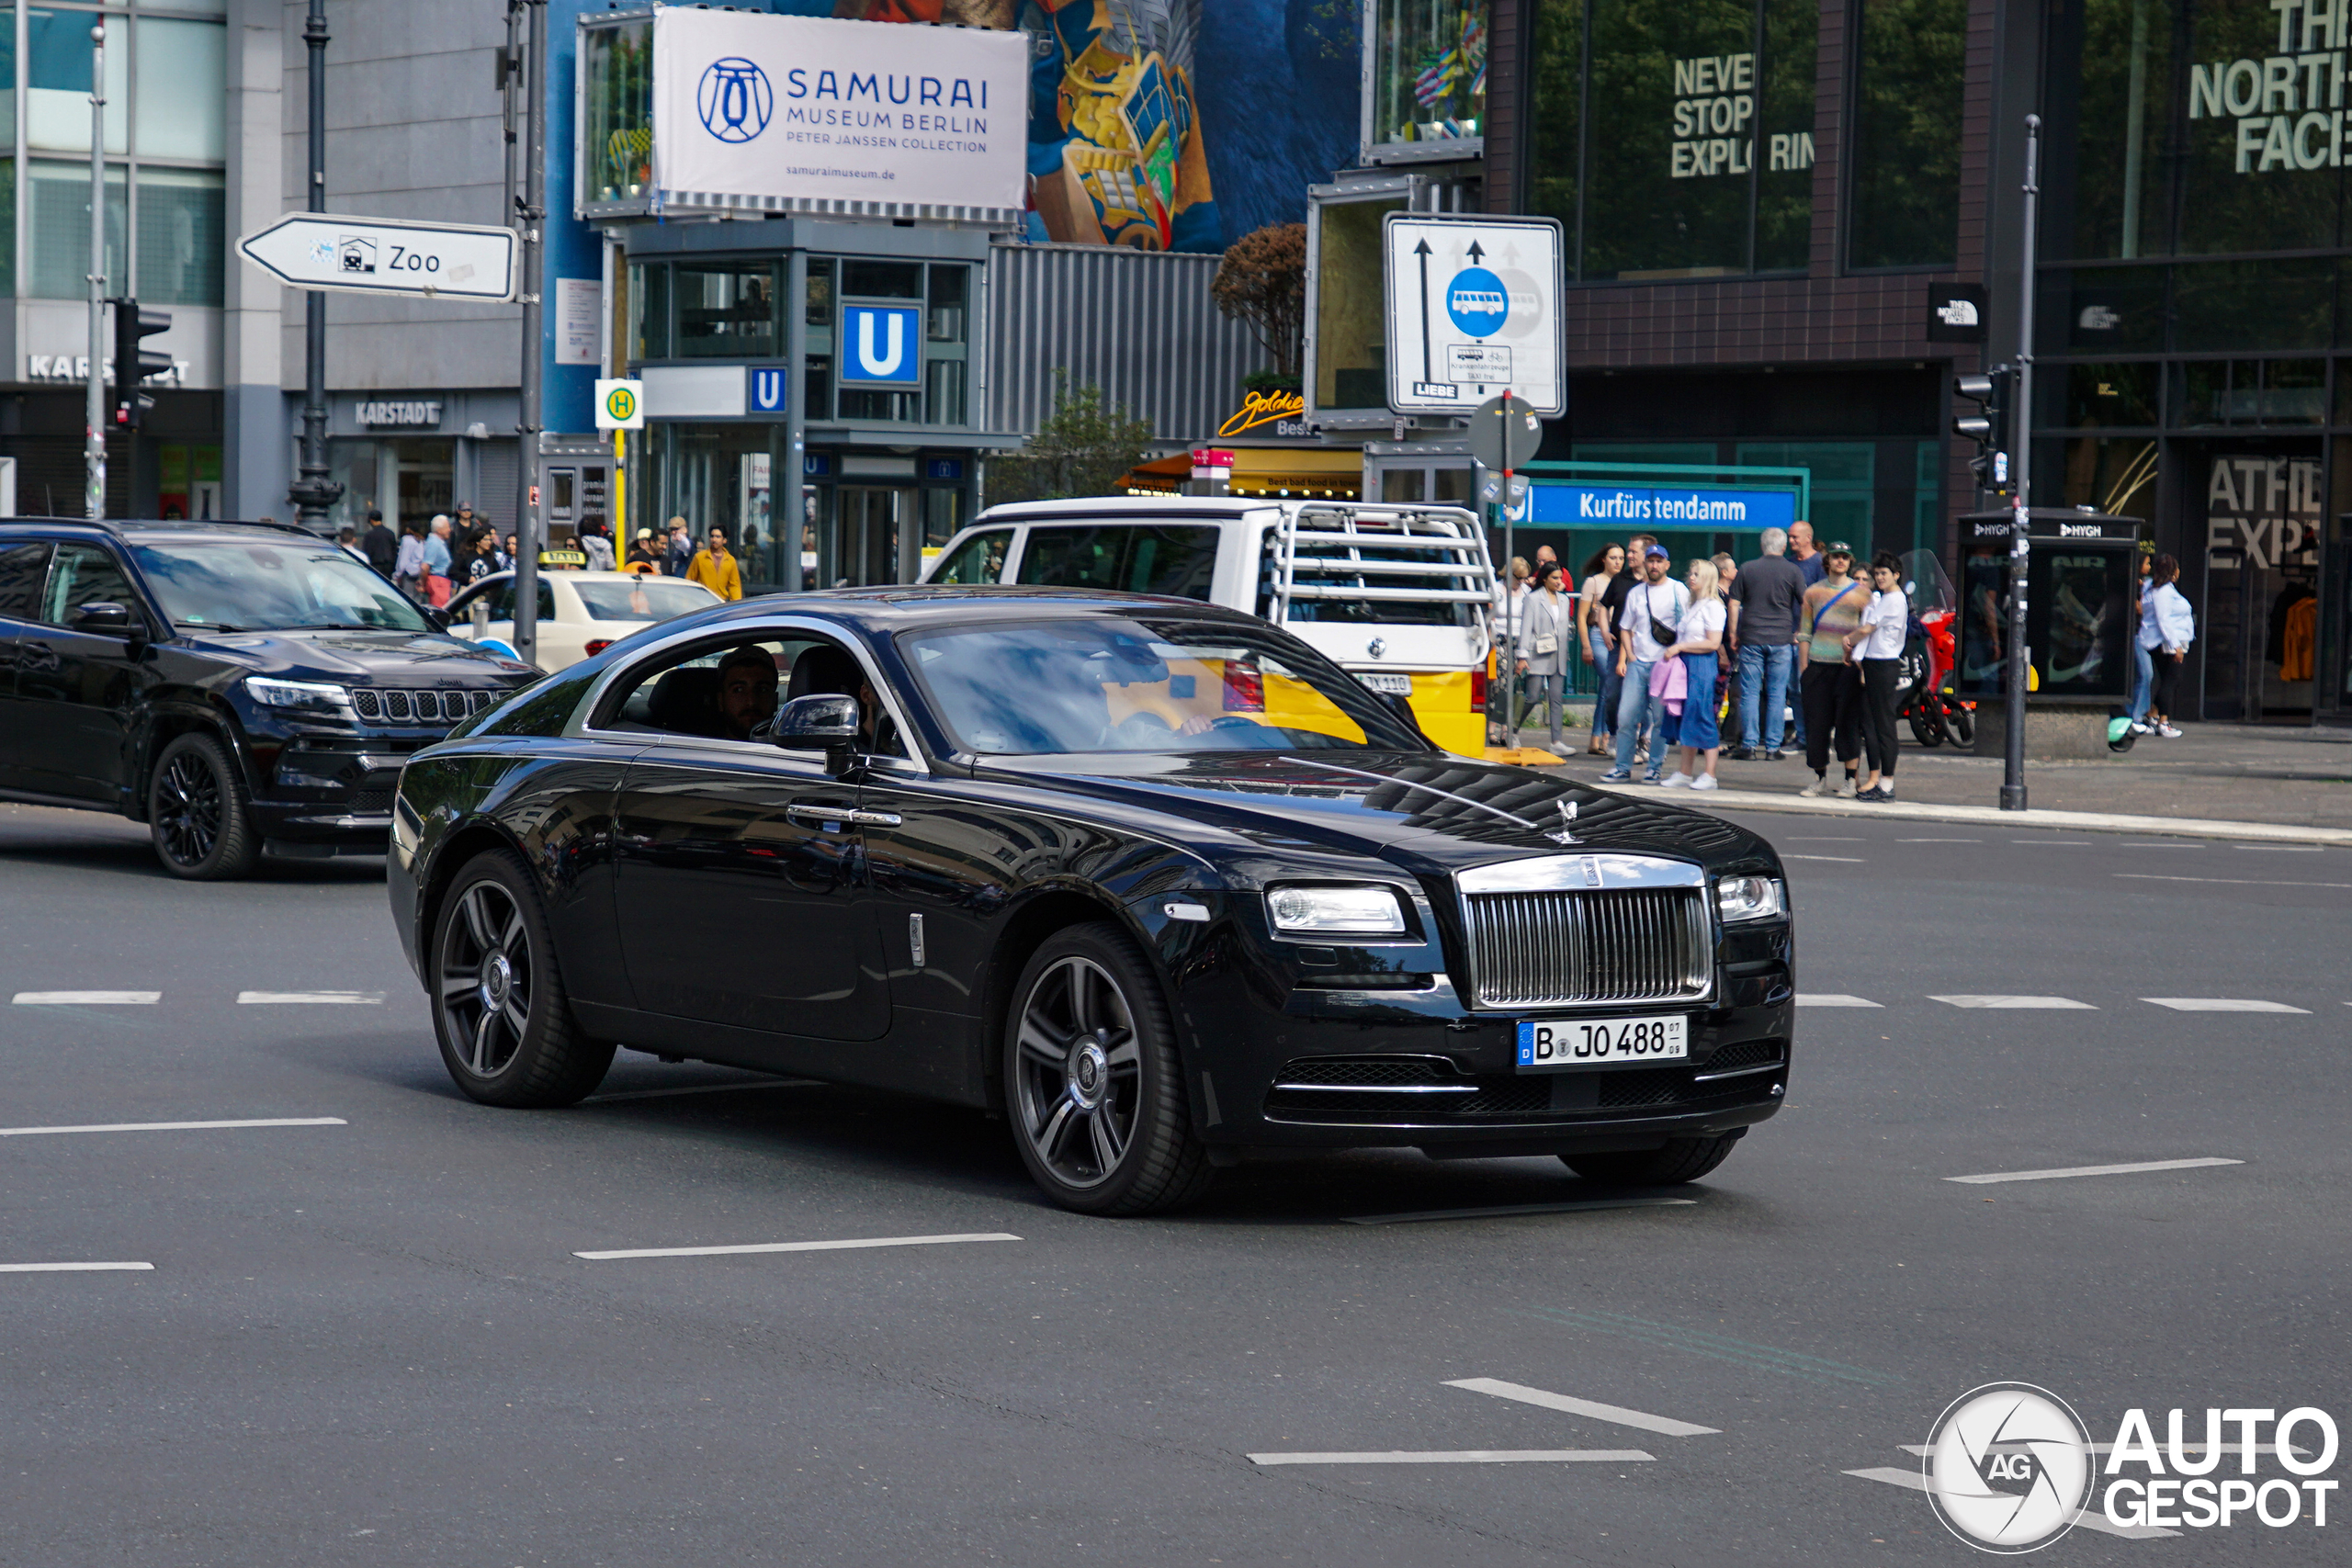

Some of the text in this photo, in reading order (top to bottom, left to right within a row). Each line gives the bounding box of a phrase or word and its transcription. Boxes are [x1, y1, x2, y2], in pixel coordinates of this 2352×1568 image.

[1675, 52, 1756, 96] NEVE
[787, 68, 987, 109] SAMURAI
[786, 107, 987, 134] MUSEUM BERLIN
[1674, 95, 1753, 138] STOP
[786, 131, 987, 153] PETER JANSSEN COLLECTION
[786, 165, 895, 180] samuraimuseum.de
[390, 245, 439, 272] Zoo
[859, 312, 903, 377] U
[1451, 362, 1510, 372] Krankenfahrzeuge
[758, 371, 779, 409] U
[1416, 383, 1456, 398] LIEBE
[356, 400, 441, 424] KARSTADT
[615, 395, 628, 413] H
[1277, 420, 1311, 436] Bes
[805, 456, 817, 474] U
[1268, 478, 1361, 487] Best bad food in town
[1984, 525, 2010, 536] HYGH
[2073, 525, 2102, 537] HYGH
[2052, 556, 2107, 570] AIR
[1522, 1021, 1665, 1060] D B JO 488
